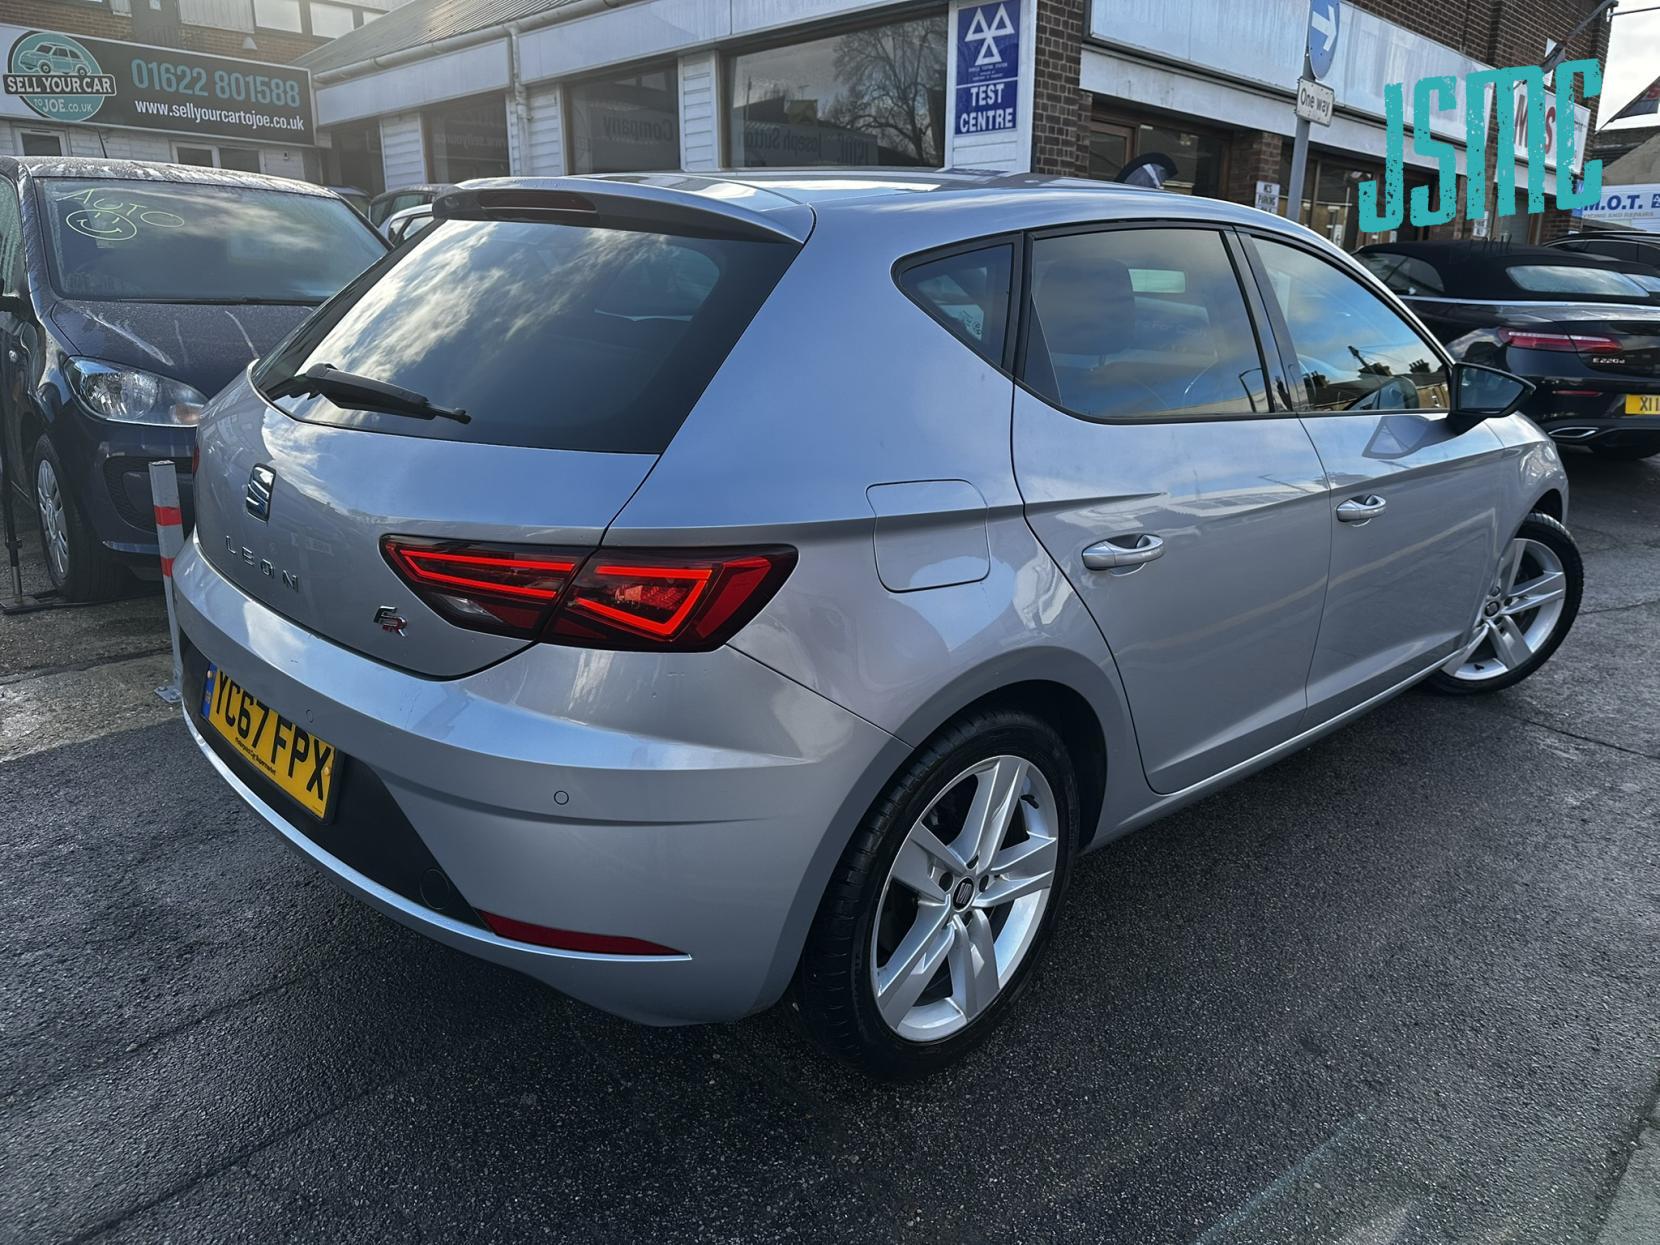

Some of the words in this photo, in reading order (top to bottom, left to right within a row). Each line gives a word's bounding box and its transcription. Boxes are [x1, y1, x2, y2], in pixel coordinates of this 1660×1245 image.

[7, 76, 41, 92] SELL
[42, 77, 81, 92] YOUR
[83, 77, 112, 93] CAR
[131, 58, 209, 96] 01622
[214, 70, 300, 108] 801588
[970, 83, 1005, 107] TEST
[135, 100, 304, 131] www.sellyourcartojoe.co.uk
[1300, 87, 1315, 109] One
[1317, 98, 1331, 118] way
[960, 107, 1014, 133] CENTRE
[56, 188, 185, 228] AUTO
[225, 535, 299, 593] LEON
[373, 605, 408, 639] FR
[216, 671, 270, 749] YC67
[271, 714, 332, 801] FPX
